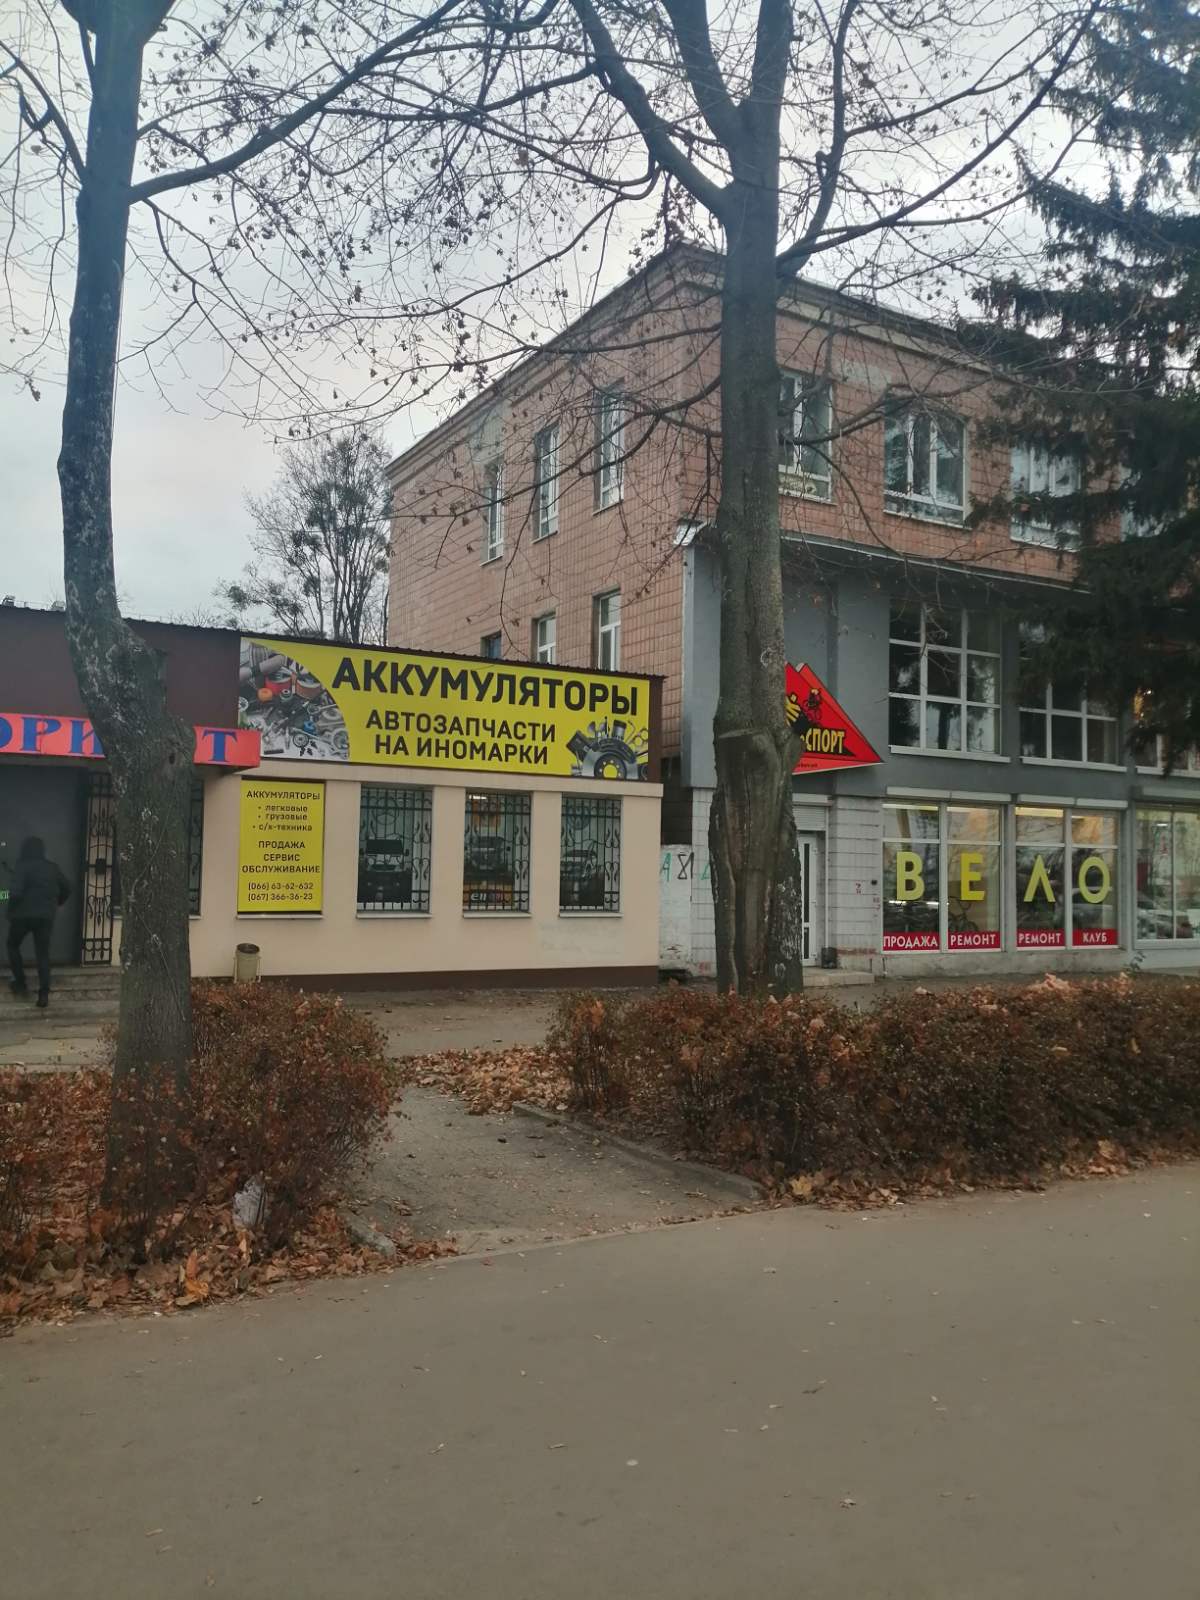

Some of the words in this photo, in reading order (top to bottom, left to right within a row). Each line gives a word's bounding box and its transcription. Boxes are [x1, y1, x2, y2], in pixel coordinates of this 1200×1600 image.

[331, 657, 638, 717] АККУМУЛЯТОРЫ
[366, 709, 556, 743] АВТОЗАПЧАСТИ
[800, 728, 846, 754] СПОРТ
[375, 734, 409, 756] НА
[416, 737, 548, 765] ИНОМАРКИ
[246, 790, 321, 800] АККУМУЛЯТОРЫ
[258, 840, 306, 850] ПРОДАЖА
[263, 853, 301, 862] СЕРВИС
[242, 864, 321, 874] ОБСЛУЖИВАНИЕ
[883, 935, 938, 948] ПРОДАЖА
[950, 933, 996, 946] РЕМОНТ
[1018, 932, 1062, 944] РЕМОНТ
[1082, 931, 1108, 943] КЛУБ
